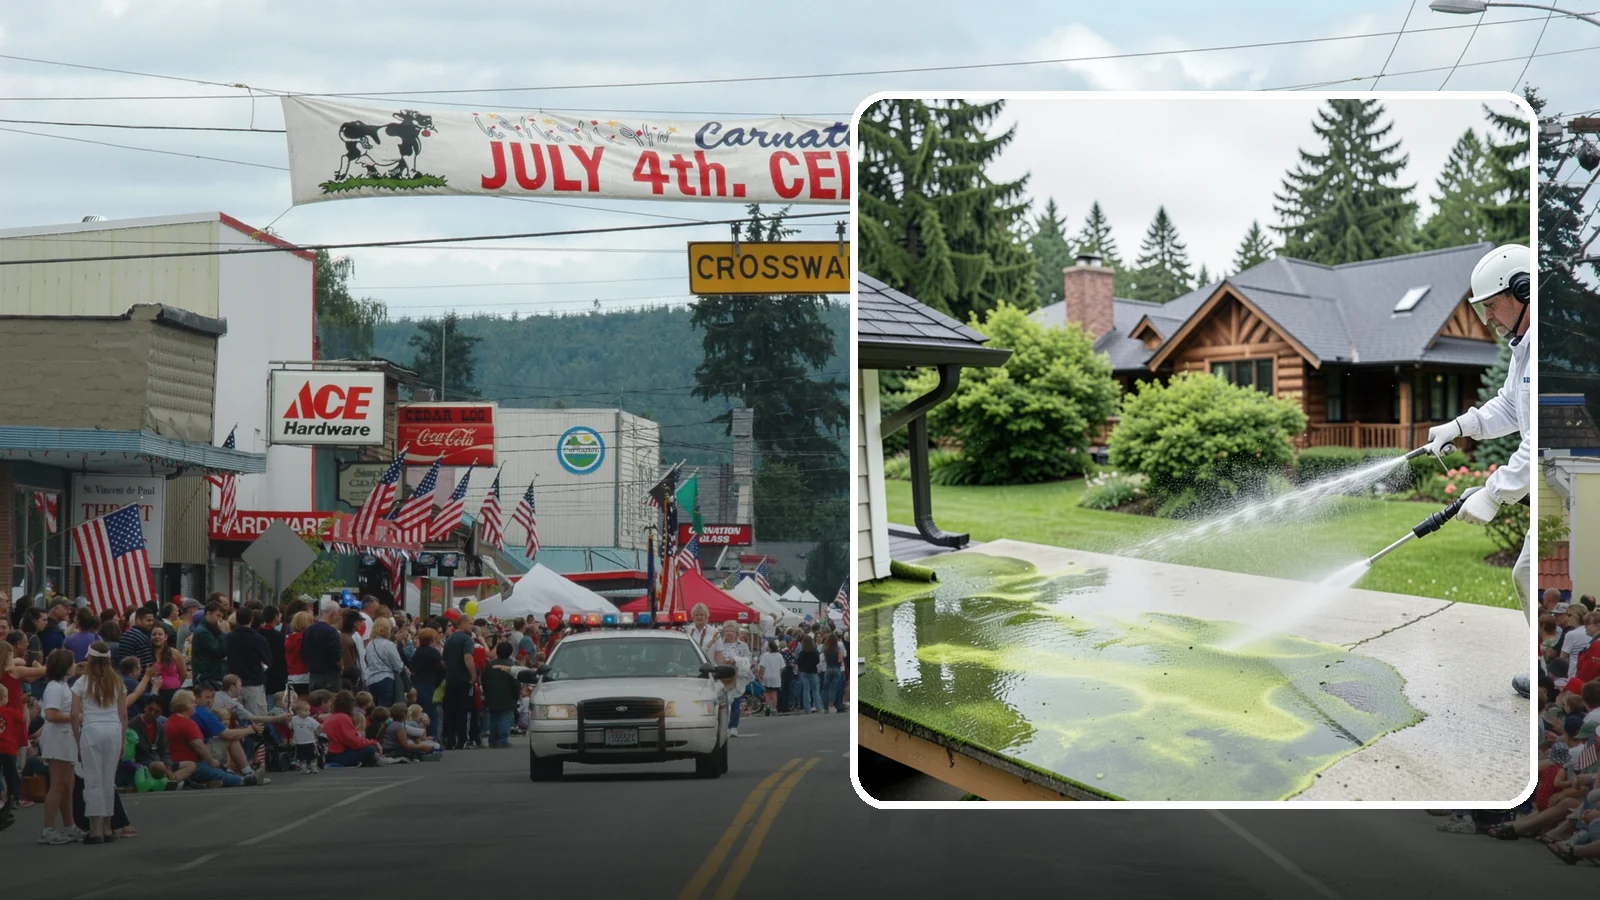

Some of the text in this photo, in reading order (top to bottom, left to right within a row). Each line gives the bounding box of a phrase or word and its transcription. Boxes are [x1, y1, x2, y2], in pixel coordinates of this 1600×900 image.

[481, 141, 605, 192] JULY
[632, 150, 746, 198] 4th.
[697, 254, 850, 280] CROSSWA
[283, 380, 373, 419] ACE
[406, 409, 485, 421] CEDAR LOG
[283, 421, 371, 436] Hardware
[416, 428, 476, 447] Coca-Cola
[354, 467, 384, 479] Simpl
[95, 484, 124, 494] Vincent
[126, 486, 135, 494] de
[137, 485, 155, 495] Paul
[212, 516, 330, 535] HARDARE
[688, 526, 742, 535] CRNATION
[699, 535, 730, 543] GLASS
